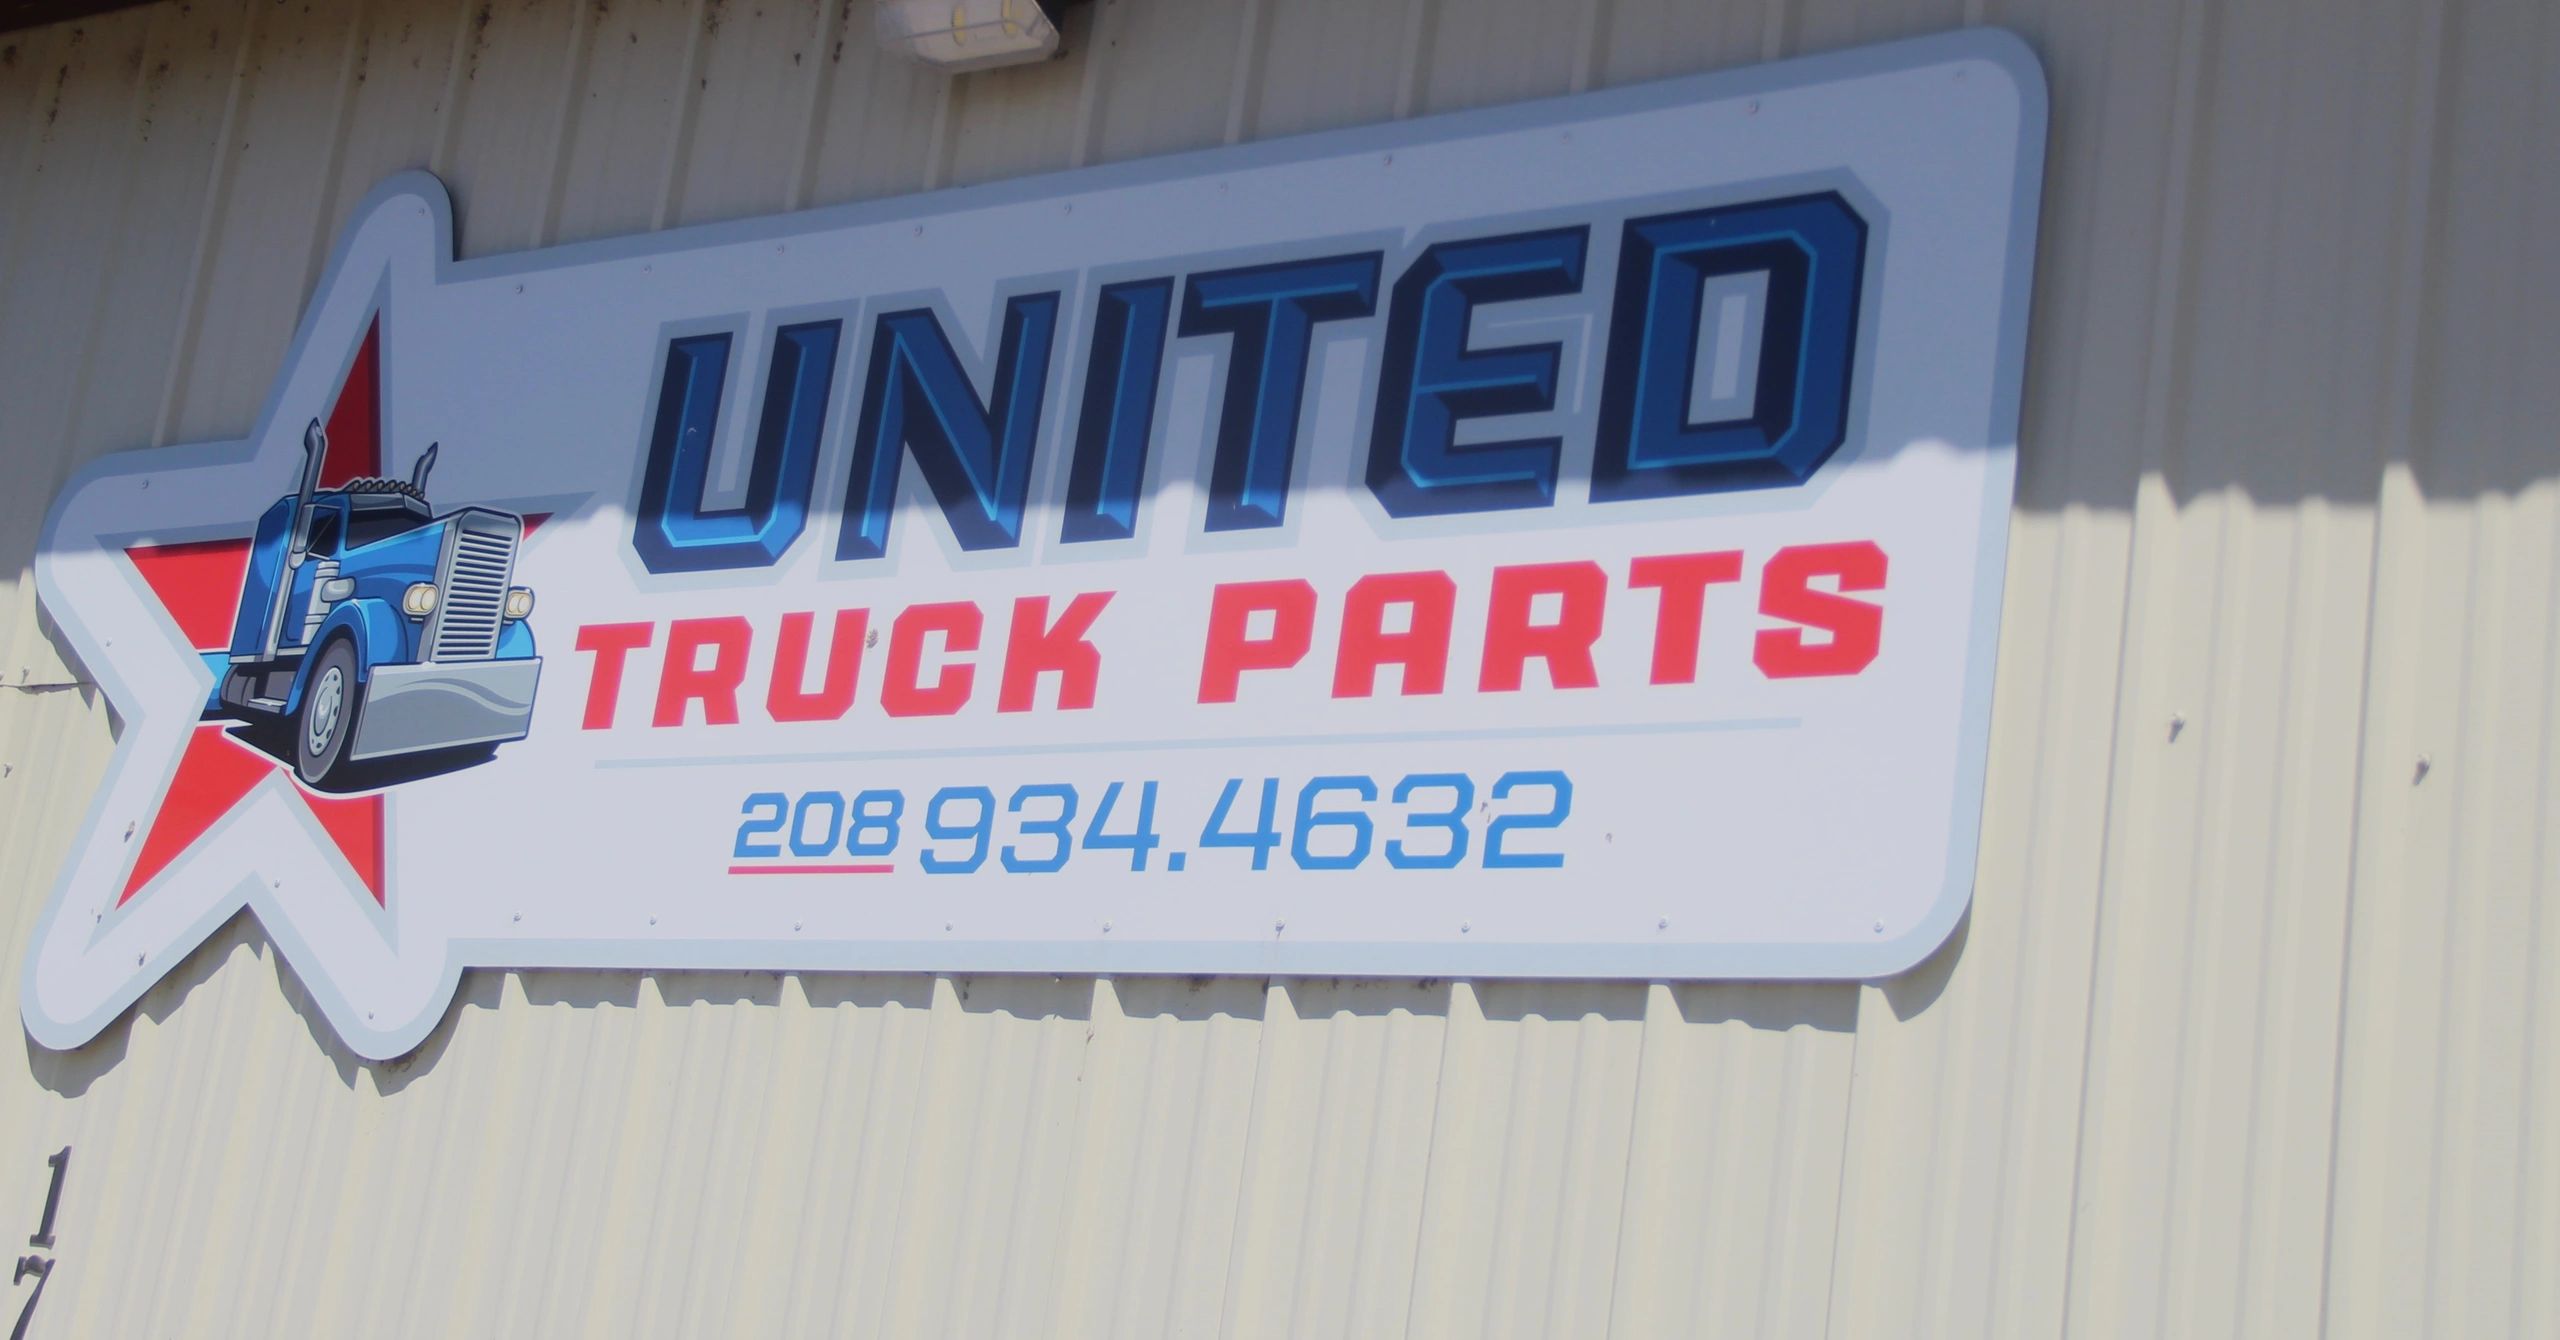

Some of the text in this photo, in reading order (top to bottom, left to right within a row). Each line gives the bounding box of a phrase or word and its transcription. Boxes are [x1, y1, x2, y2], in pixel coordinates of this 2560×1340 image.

[632, 190, 1869, 574] UNITED
[576, 541, 1889, 730] TRUCK PARTS
[733, 770, 1574, 874] 208 934.4632
